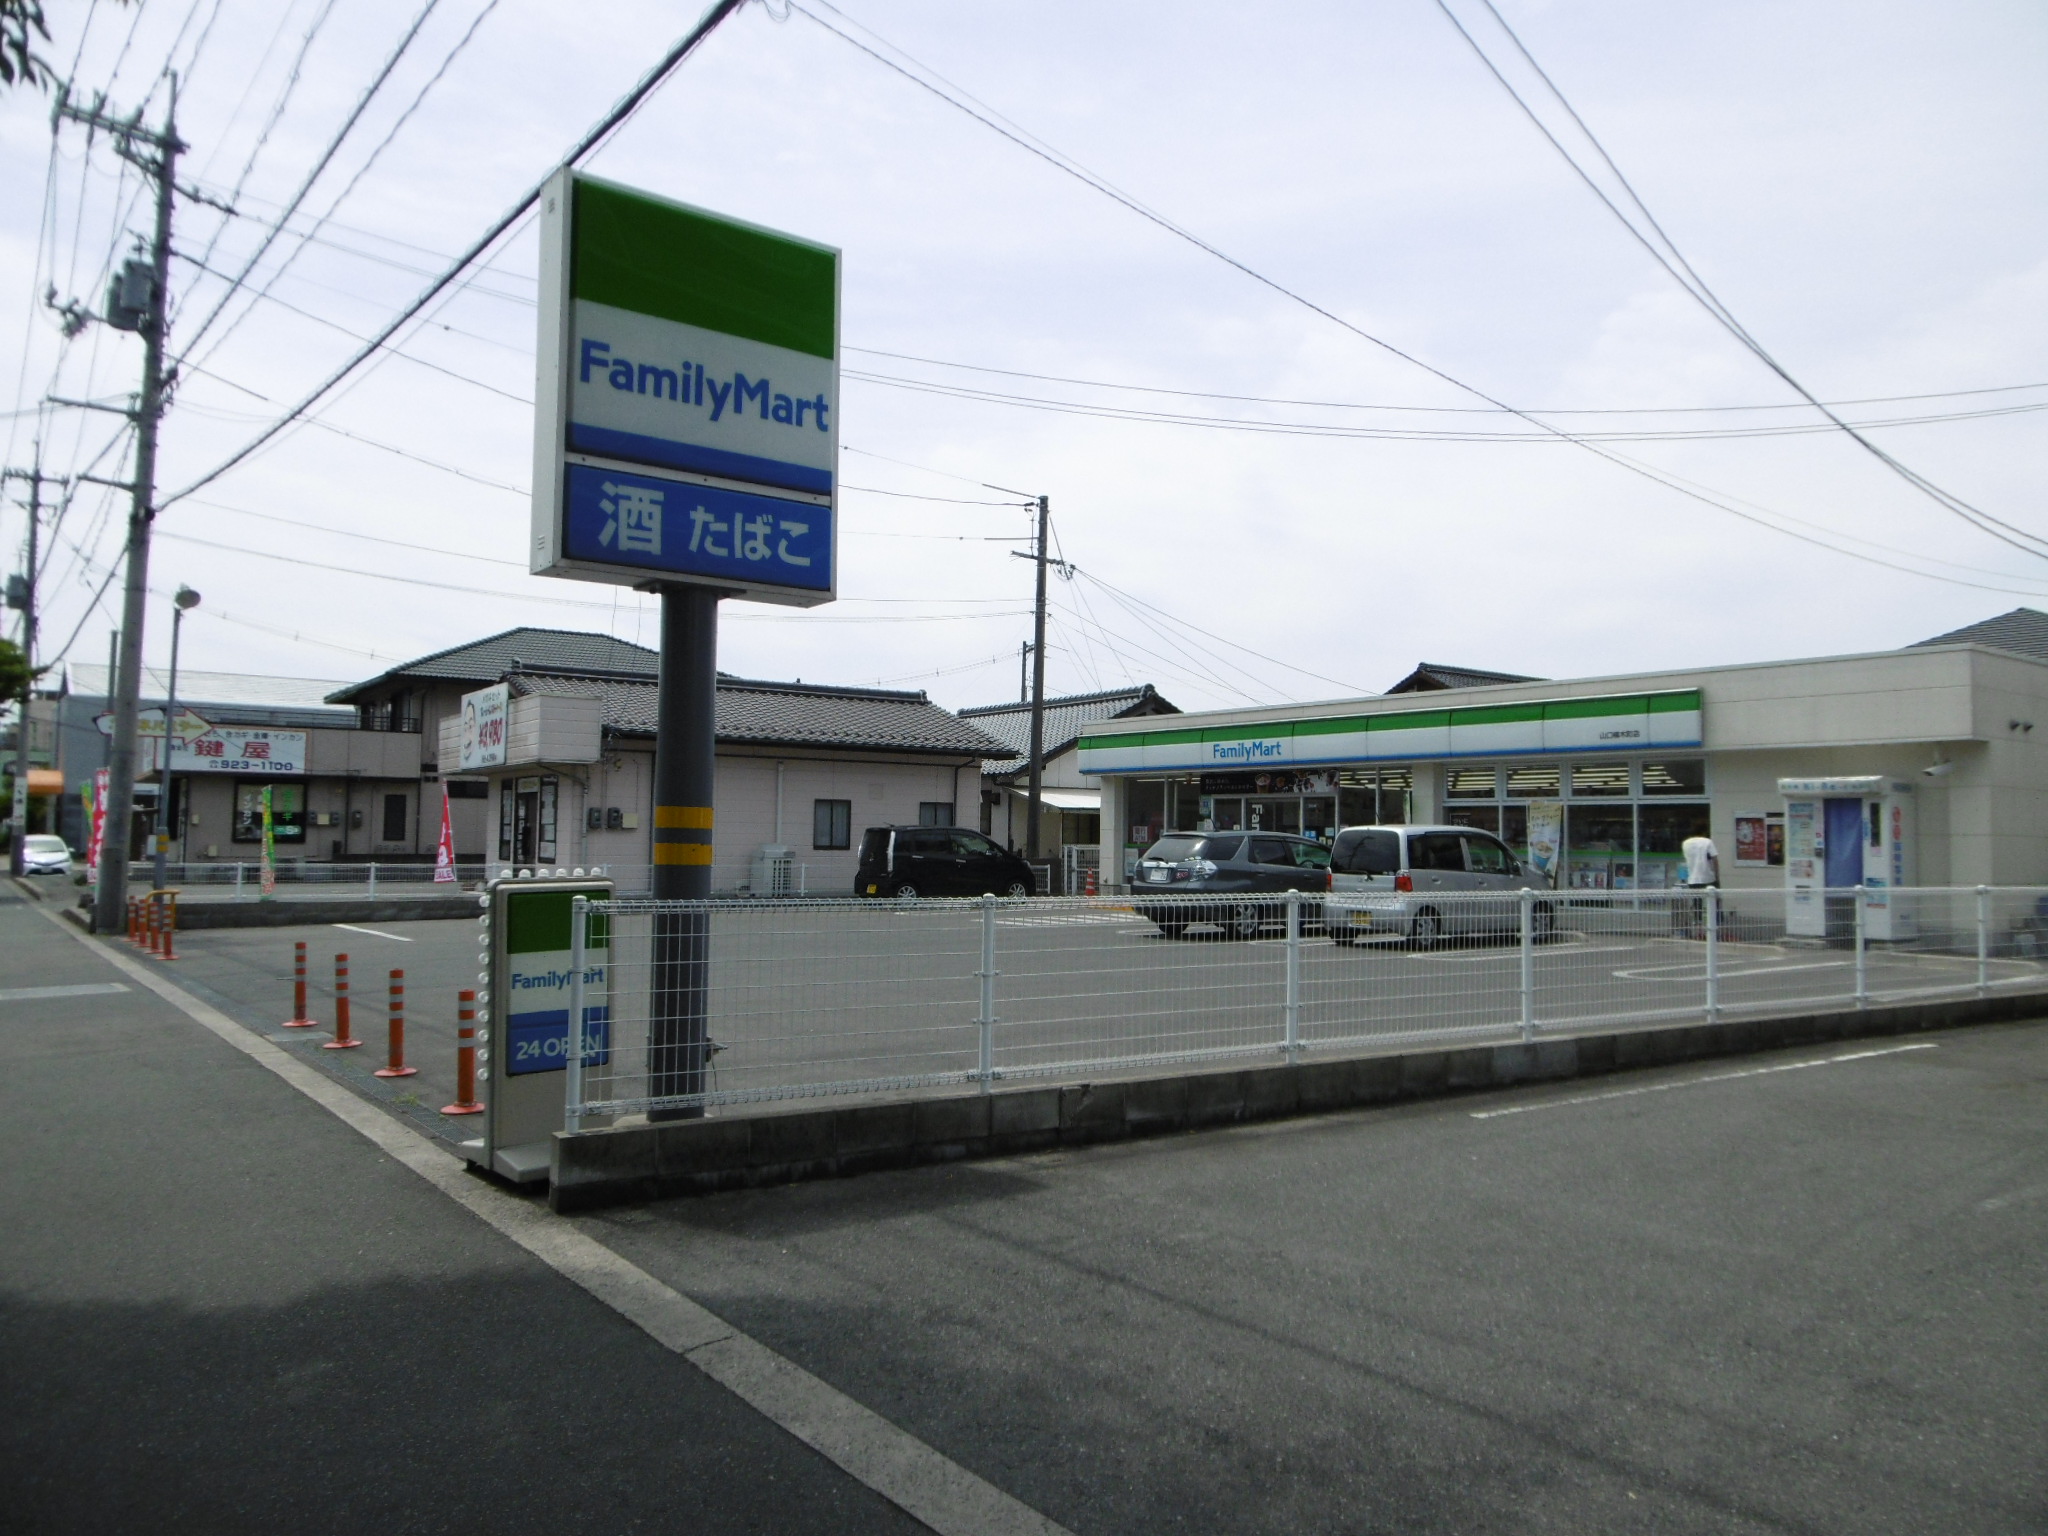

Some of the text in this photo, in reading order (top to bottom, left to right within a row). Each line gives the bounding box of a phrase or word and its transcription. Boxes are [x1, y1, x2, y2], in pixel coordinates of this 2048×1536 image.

[579, 337, 829, 433] FamilyMart
[597, 480, 811, 567] 酒 たばこ
[1213, 740, 1282, 761] FamilyMart
[219, 759, 294, 771] 923-1100
[516, 1040, 541, 1060] 24
